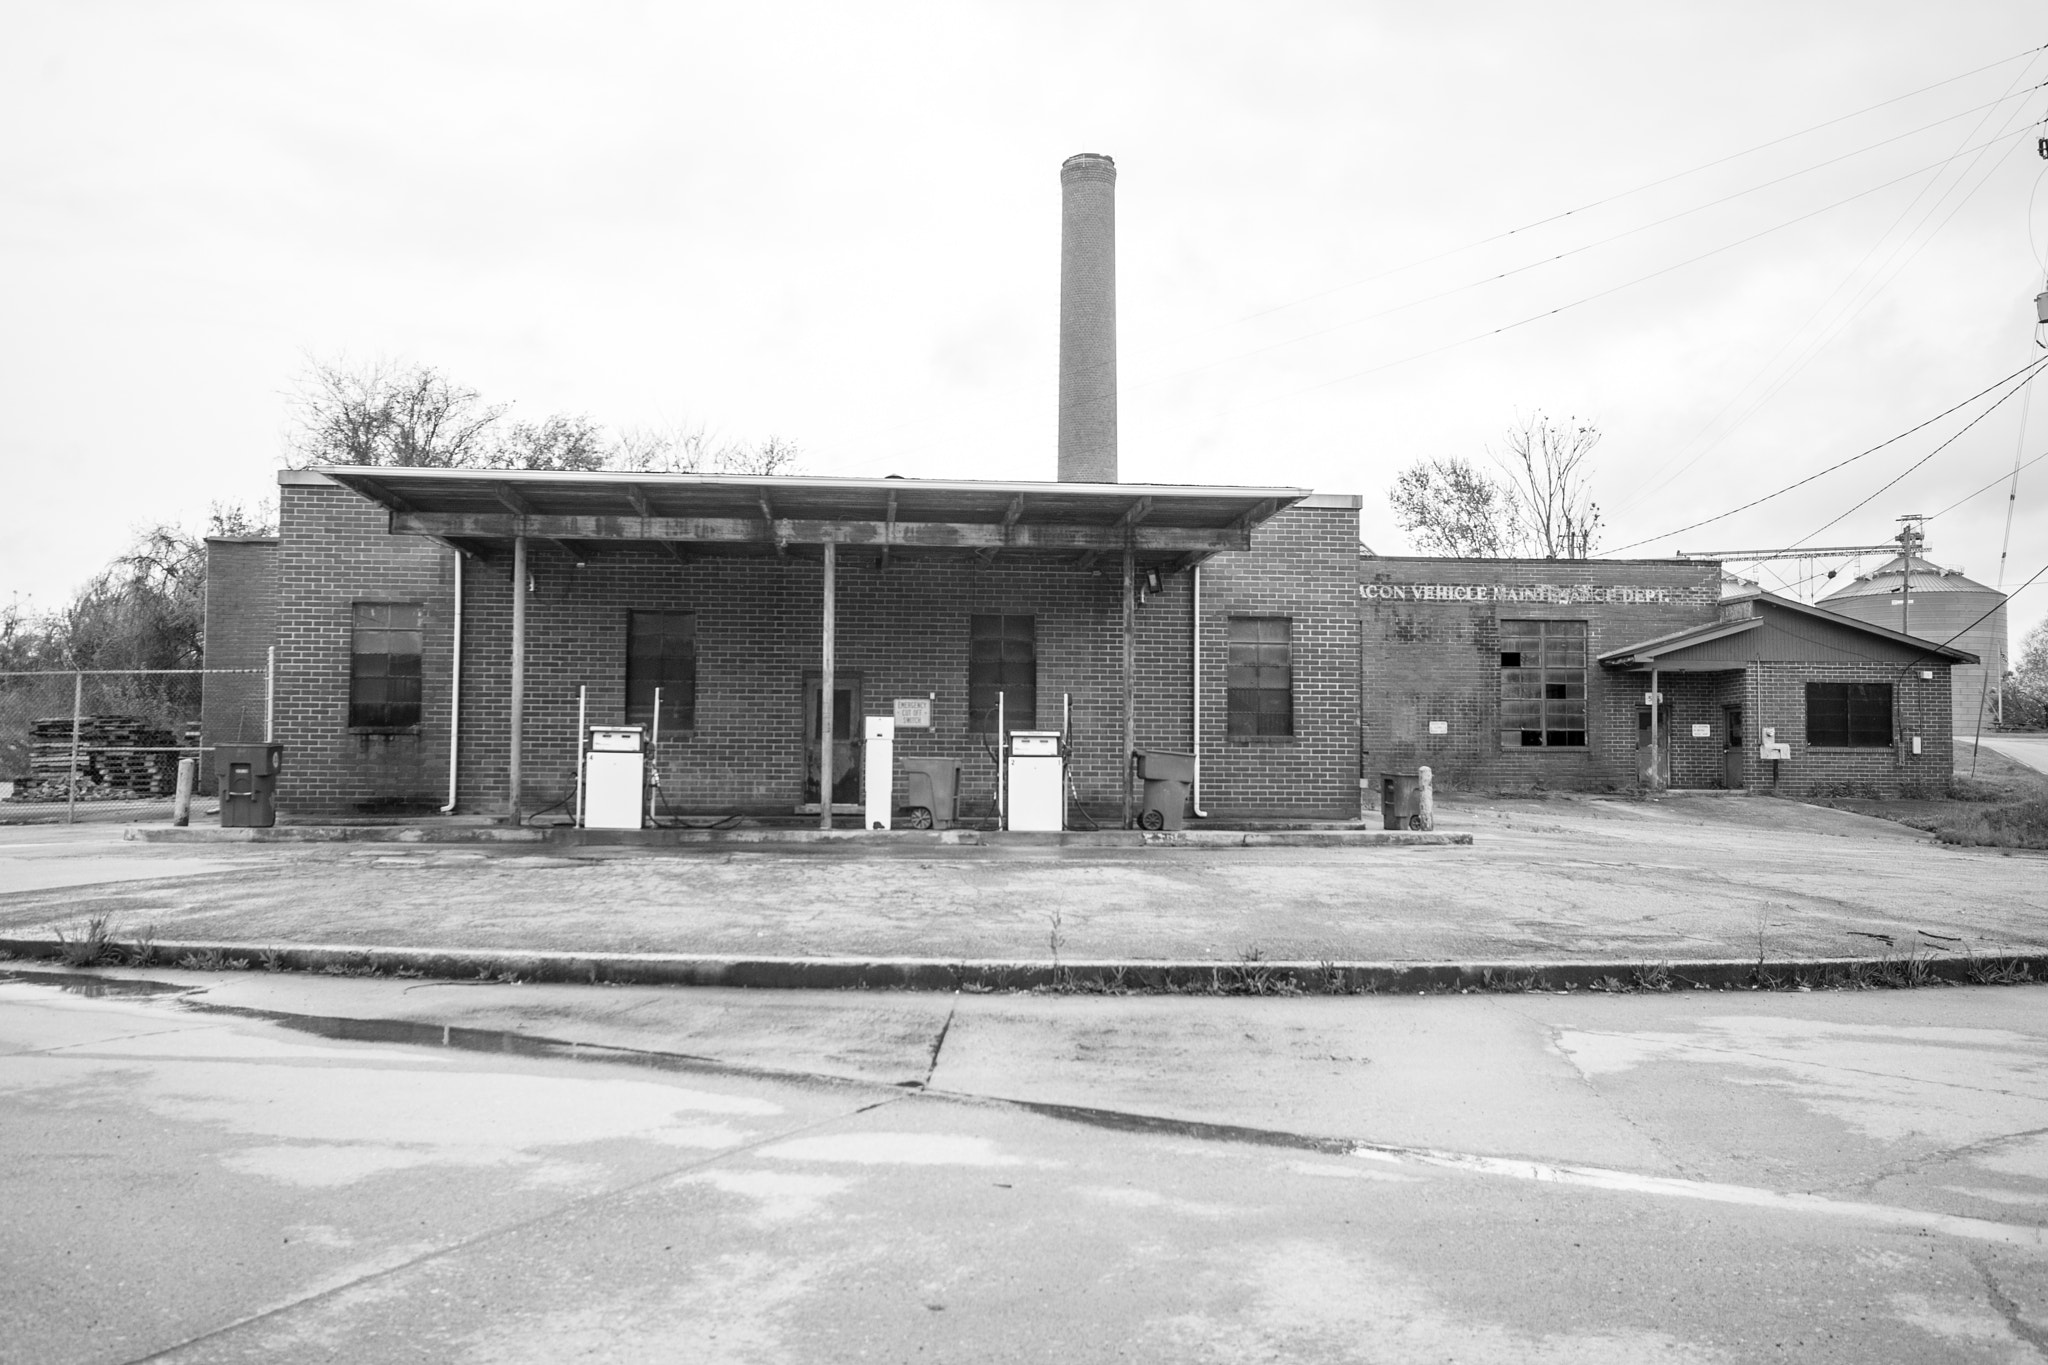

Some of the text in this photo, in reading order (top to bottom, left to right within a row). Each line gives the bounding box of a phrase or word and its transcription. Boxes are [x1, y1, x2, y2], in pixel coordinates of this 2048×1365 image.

[1411, 585, 1488, 601] VEHICLE
[897, 701, 927, 709] EMERGENCY
[912, 709, 922, 717] OFF
[902, 716, 922, 724] SWITCH
